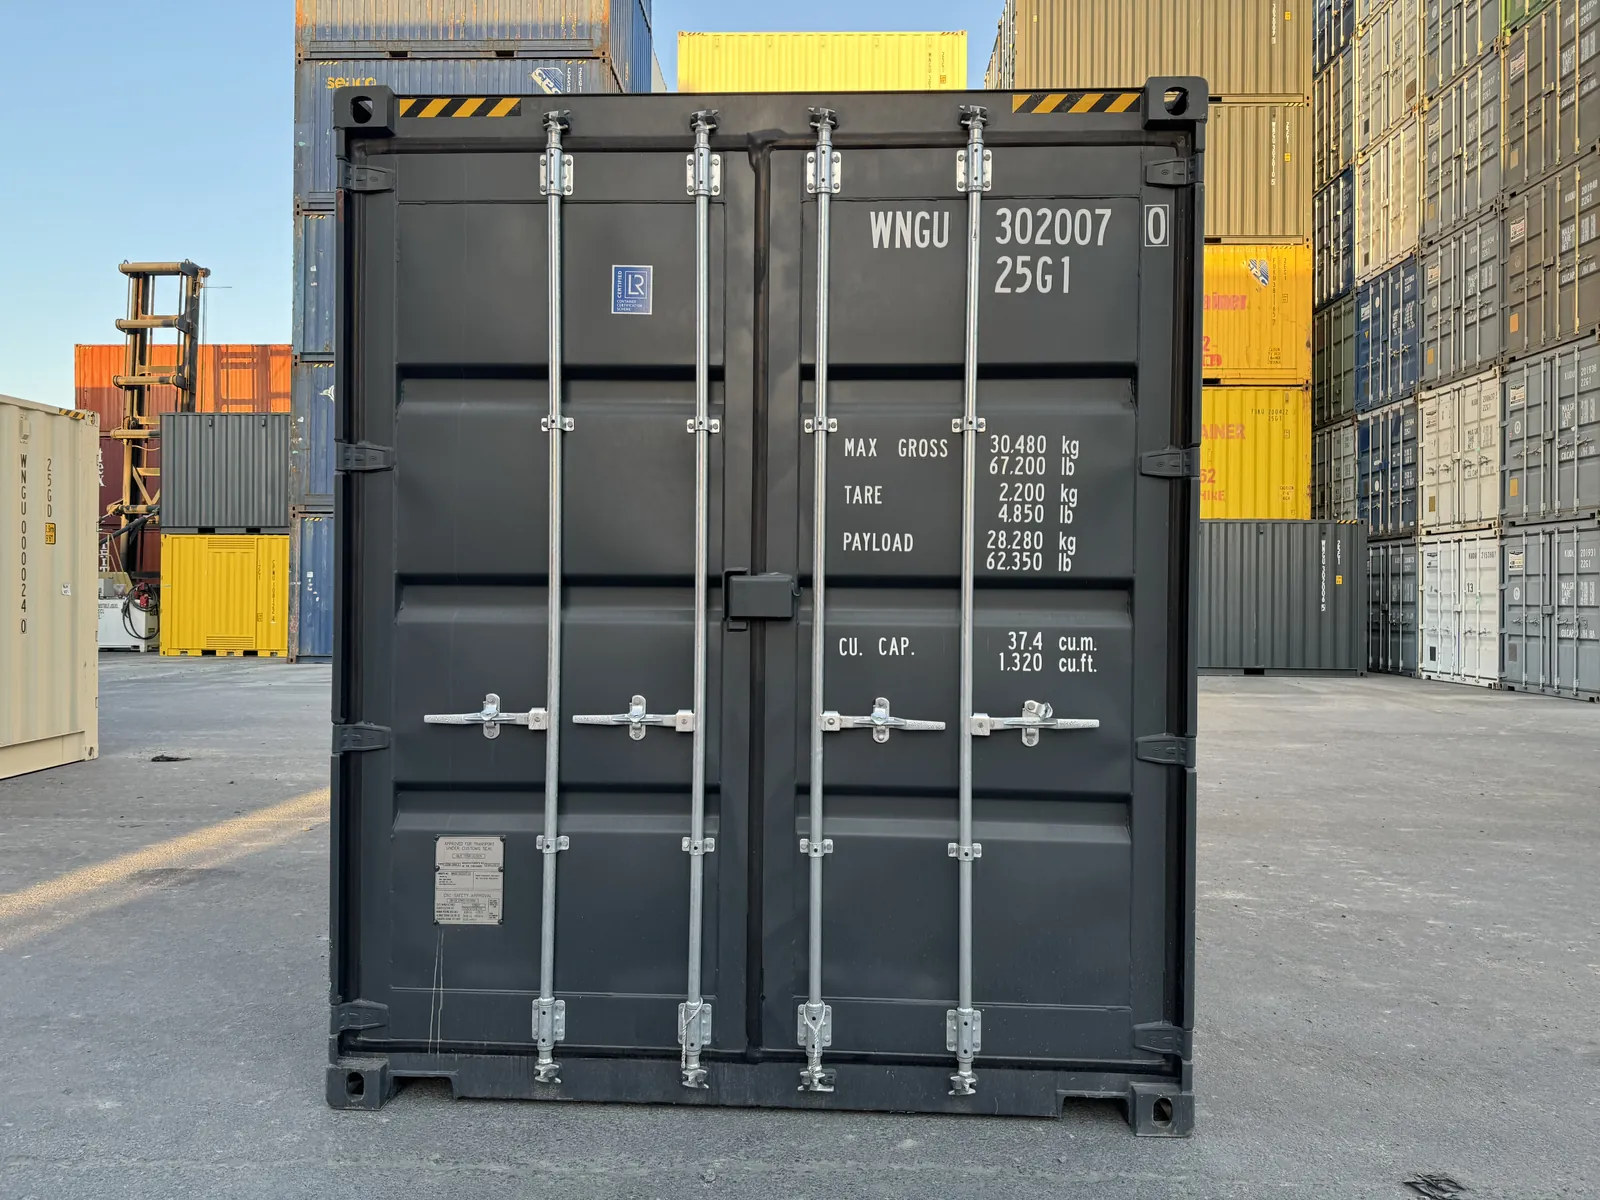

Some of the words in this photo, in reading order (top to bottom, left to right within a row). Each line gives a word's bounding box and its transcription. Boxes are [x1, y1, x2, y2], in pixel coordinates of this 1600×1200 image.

[870, 211, 949, 248] WNGU
[996, 208, 1111, 246] 302007
[1148, 207, 1166, 244] 0
[628, 274, 645, 295] LR
[995, 256, 1070, 294] 25G1
[845, 438, 877, 457] MAX
[898, 439, 948, 457] GROSS
[990, 435, 1046, 455] 30,480
[1062, 436, 1079, 459] kg
[989, 456, 1046, 476] 67,200
[1061, 457, 1075, 476] lb
[845, 486, 882, 504] TARE
[999, 483, 1045, 503] 2,200
[1061, 484, 1078, 507] kg
[998, 504, 1044, 524] 4,850
[1060, 505, 1073, 523] lb
[843, 533, 914, 551] PAYLOAD
[987, 530, 1043, 550] 28,280
[1059, 532, 1076, 555] kg
[986, 552, 1042, 571] 62,350
[1058, 553, 1072, 572] lb
[1467, 583, 1474, 592] 13
[839, 638, 863, 656] CU.
[878, 637, 915, 656] CAP.
[1008, 632, 1043, 651] 37.4
[1059, 637, 1097, 651] cu.m.
[999, 653, 1042, 672] 1,320
[1059, 653, 1097, 673] cu.ft.
